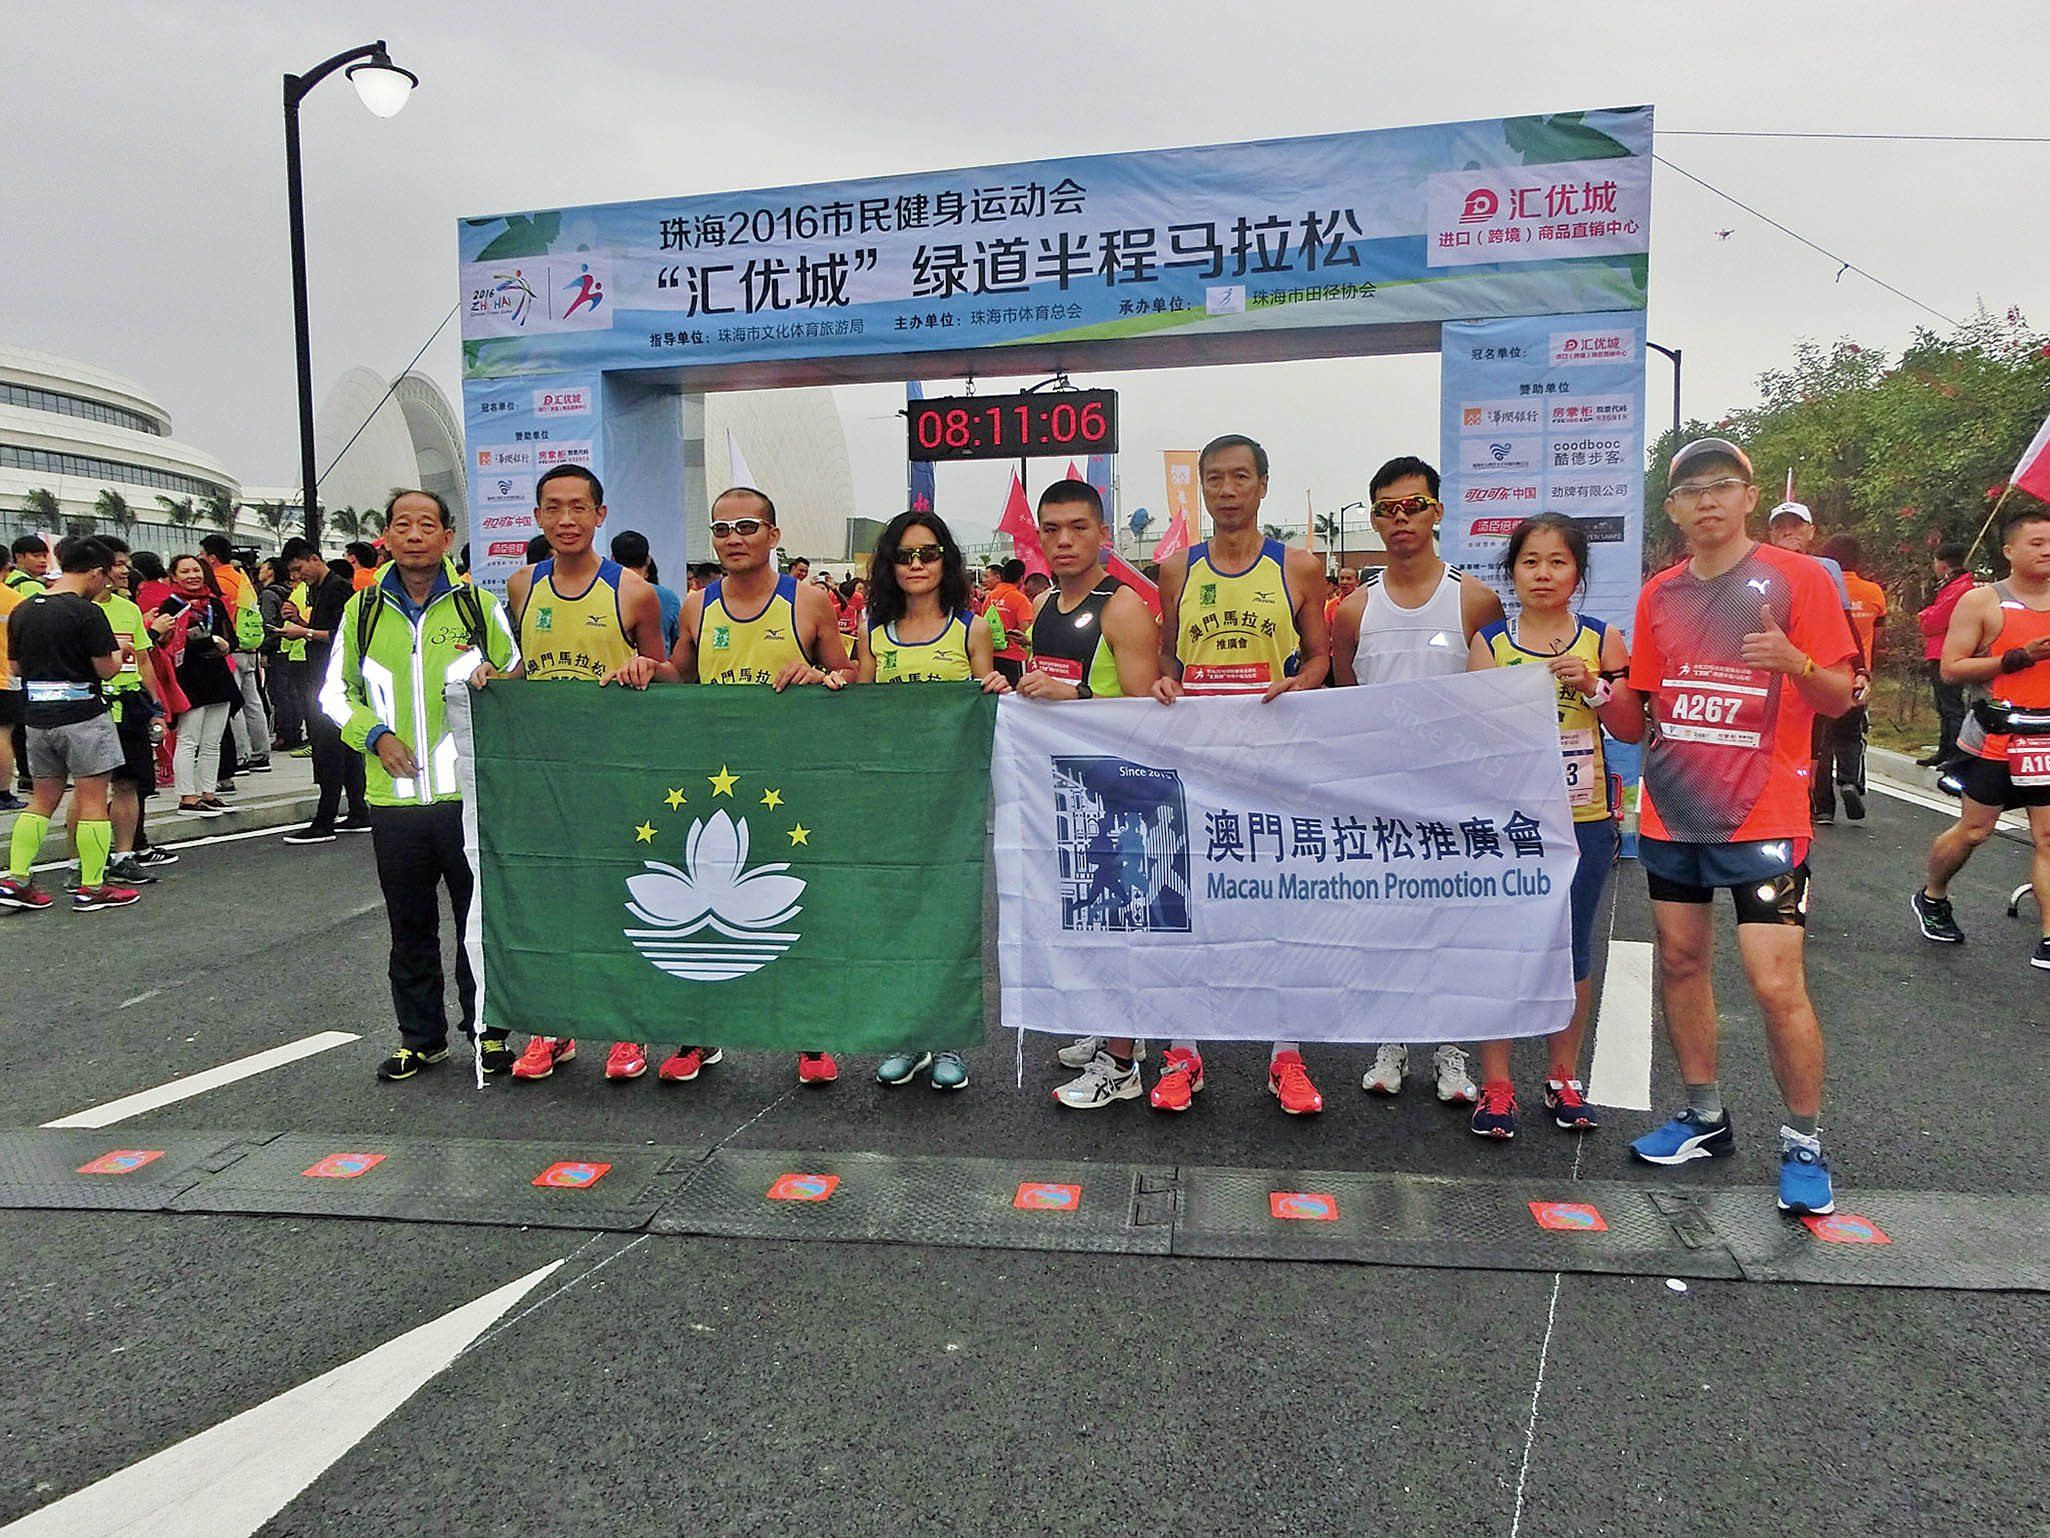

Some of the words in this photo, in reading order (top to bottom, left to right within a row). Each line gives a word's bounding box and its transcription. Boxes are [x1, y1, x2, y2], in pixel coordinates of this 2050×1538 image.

[659, 178, 1087, 250] 珠海2016市民健身运动会
[1509, 181, 1617, 220] 汇优城
[1439, 219, 1640, 247] 进口（跨境）商品直销中心
[657, 249, 877, 317] “汇优城”
[912, 209, 1363, 299] 绿道半程马拉松
[473, 289, 495, 300] 2016
[1119, 296, 1192, 315] 承办单位：
[1252, 281, 1376, 306] 珠海市田径协会
[894, 313, 961, 331] 主办单位：
[970, 302, 1083, 325] 珠海市体育总会
[650, 331, 710, 348] 指导单位：
[718, 319, 864, 343] 珠海市文化体育旅游局
[1581, 337, 1620, 350] 汇优城
[1471, 349, 1527, 361] 冠名单位：
[1519, 382, 1570, 396] 赞助单位
[918, 402, 1107, 448] 08:11:06
[1552, 406, 1593, 418] 房掌柜
[1553, 439, 1621, 451] coodbooc
[1553, 451, 1621, 466] 酷德步客
[1551, 484, 1628, 497] 劲牌有限公司
[1188, 610, 1276, 643] 澳門馬拉松
[1672, 694, 1743, 724] A267
[1119, 765, 1146, 777] Since
[1205, 809, 1545, 863] 澳門馬拉松推廣會
[1207, 872, 1273, 900] Macau
[1278, 871, 1379, 900] Marathon
[1384, 870, 1497, 899] Promotion
[1502, 867, 1551, 897] Club
